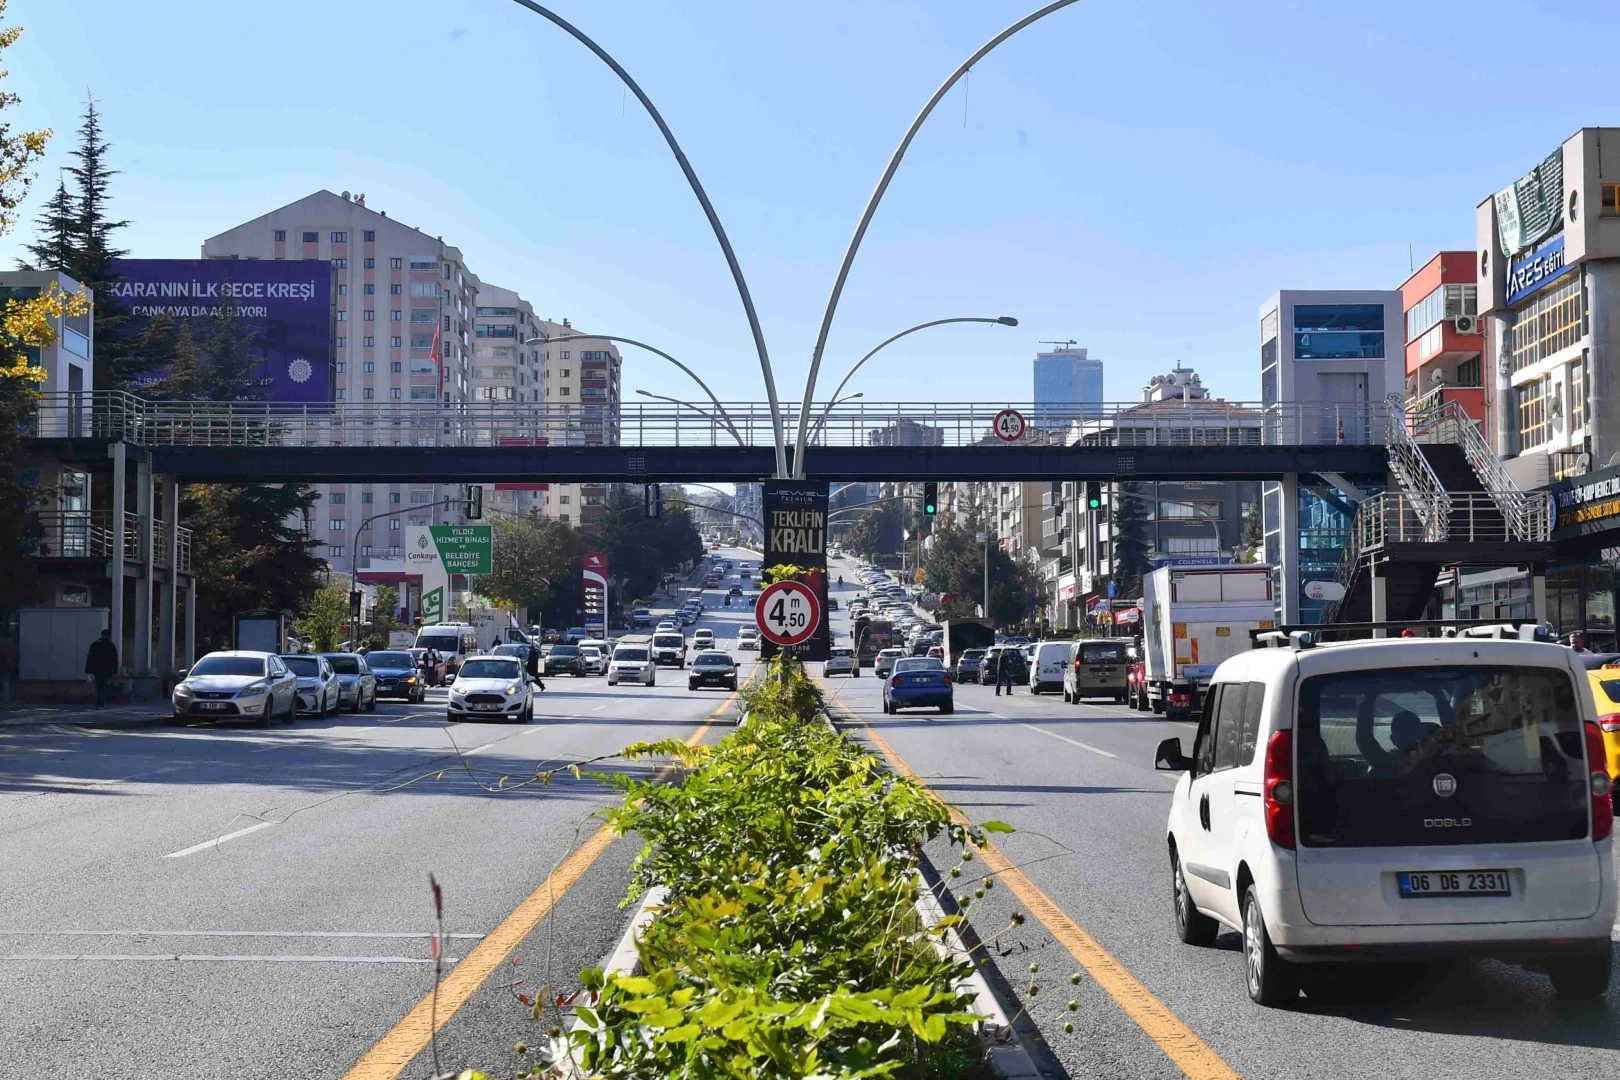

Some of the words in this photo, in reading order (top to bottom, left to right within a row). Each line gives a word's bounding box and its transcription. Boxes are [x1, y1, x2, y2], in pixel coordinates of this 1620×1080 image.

[1510, 257, 1543, 296] ARES
[192, 279, 219, 298] İLK
[220, 282, 264, 298] GECE
[267, 279, 315, 301] KREŞİ
[768, 489, 827, 497] JEWEL
[772, 508, 824, 528] TEKLİFİN
[451, 528, 475, 536] YILDIZ
[436, 536, 464, 544] HİZMET
[464, 536, 490, 544] BİNASI
[770, 528, 824, 554] KRALI
[407, 552, 438, 561] Çankaya
[445, 551, 481, 560] BELEDİYE
[447, 559, 479, 568] BAHÇESİ
[1438, 779, 1452, 791] FIAT
[1424, 817, 1472, 828] DOBLO
[1410, 875, 1430, 891] 06
[1440, 874, 1460, 890] DG
[1467, 873, 1506, 890] 2331
